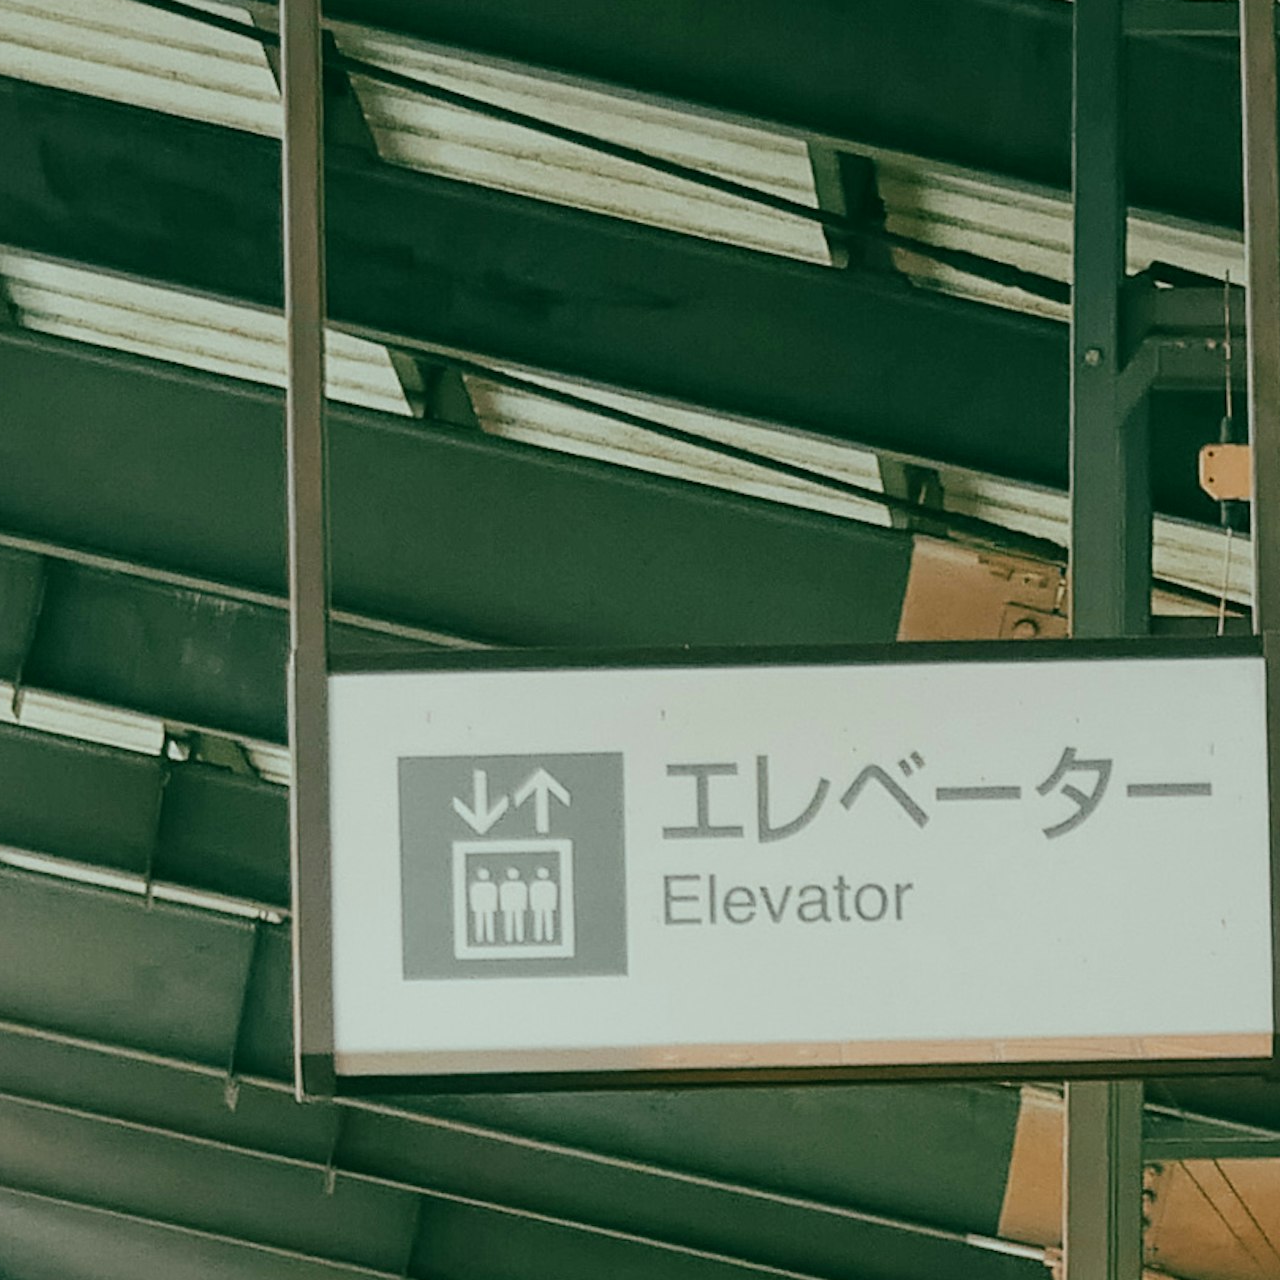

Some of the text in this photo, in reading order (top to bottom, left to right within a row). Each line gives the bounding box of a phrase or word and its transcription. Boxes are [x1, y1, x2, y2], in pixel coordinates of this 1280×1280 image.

[661, 746, 1214, 844] エレベーター
[661, 871, 915, 927] Elevator
